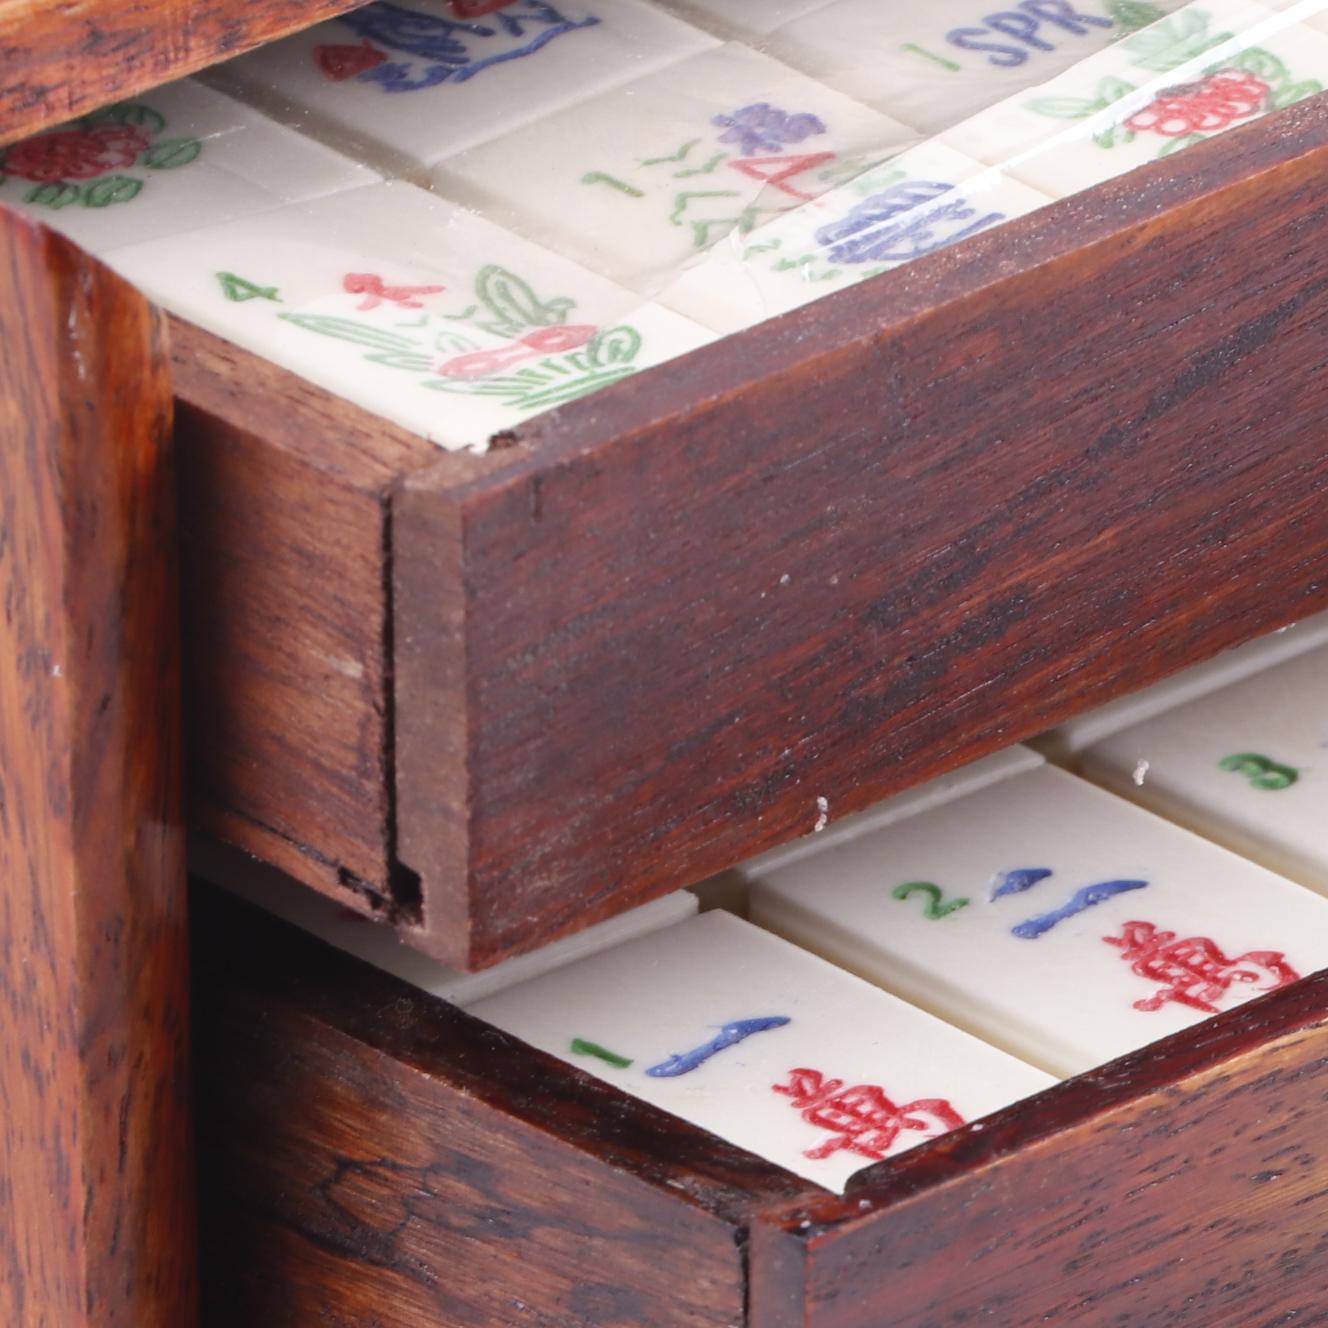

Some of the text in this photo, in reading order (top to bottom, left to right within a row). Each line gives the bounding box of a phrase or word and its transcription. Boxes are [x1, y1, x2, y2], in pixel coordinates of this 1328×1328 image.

[215, 271, 281, 304] 4
[1221, 752, 1300, 792] 3
[894, 882, 969, 919] 2
[570, 1038, 631, 1068] 1
